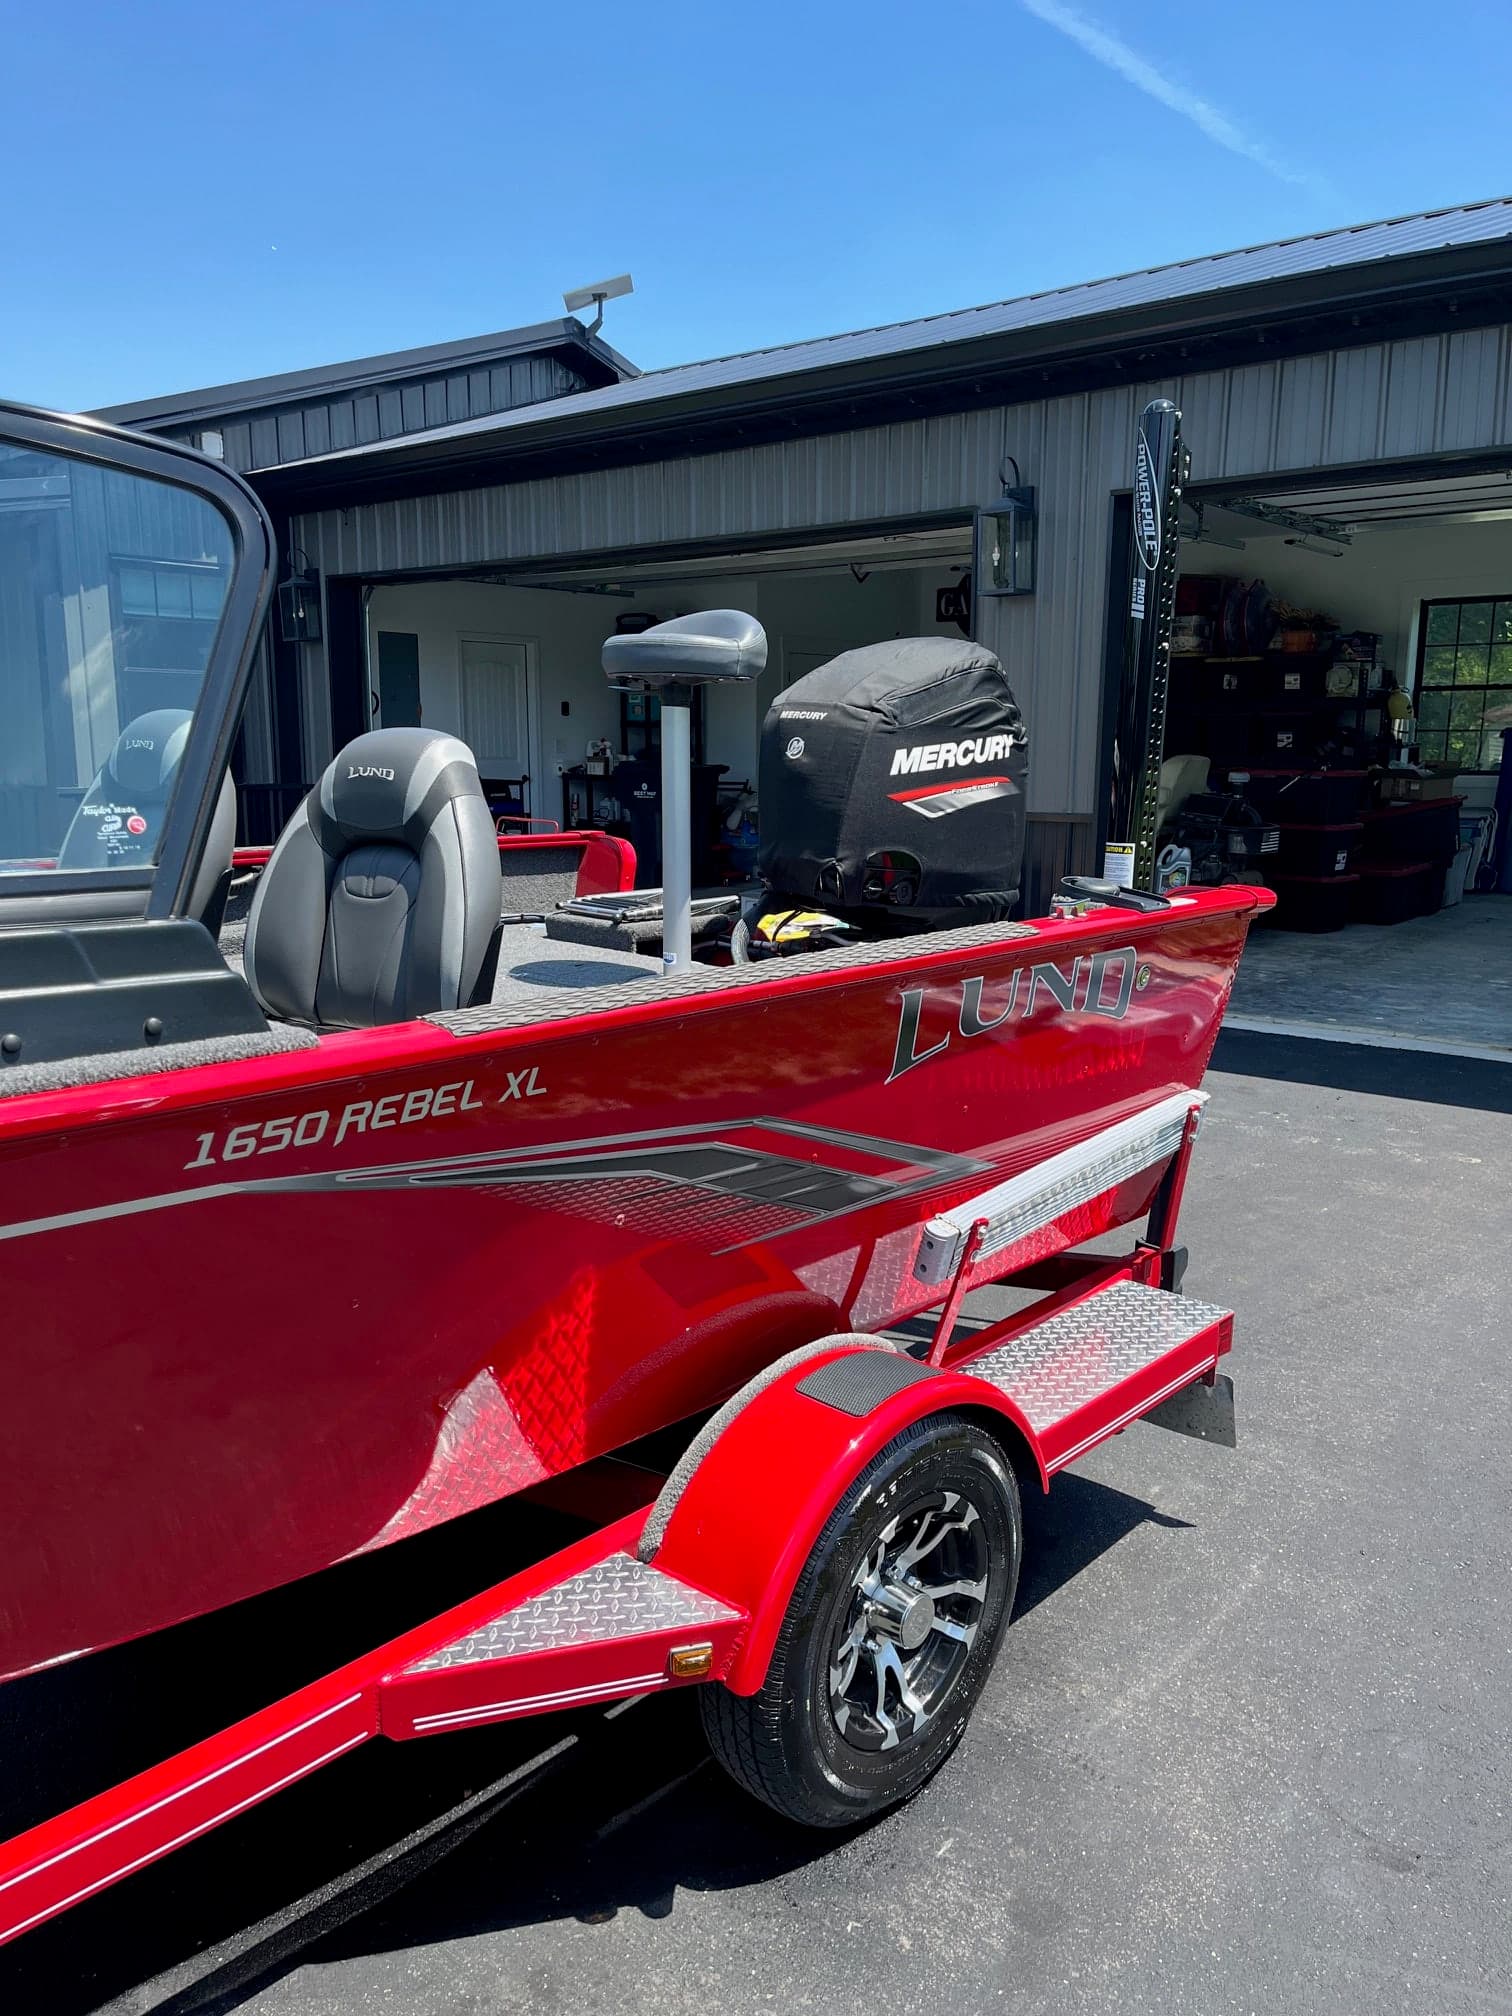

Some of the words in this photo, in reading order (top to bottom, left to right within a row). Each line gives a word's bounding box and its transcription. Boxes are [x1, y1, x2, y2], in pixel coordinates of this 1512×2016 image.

[1138, 443, 1158, 550] POWER-POLE
[1137, 579, 1146, 604] PRO
[780, 710, 829, 720] MERCURY
[126, 739, 154, 750] LUND
[890, 734, 1014, 776] MERCURY
[347, 766, 395, 781] LUND
[884, 946, 1137, 1085] LUND
[183, 1109, 331, 1170] 1650
[333, 1079, 484, 1147] REBEL
[498, 1066, 548, 1103] XL
